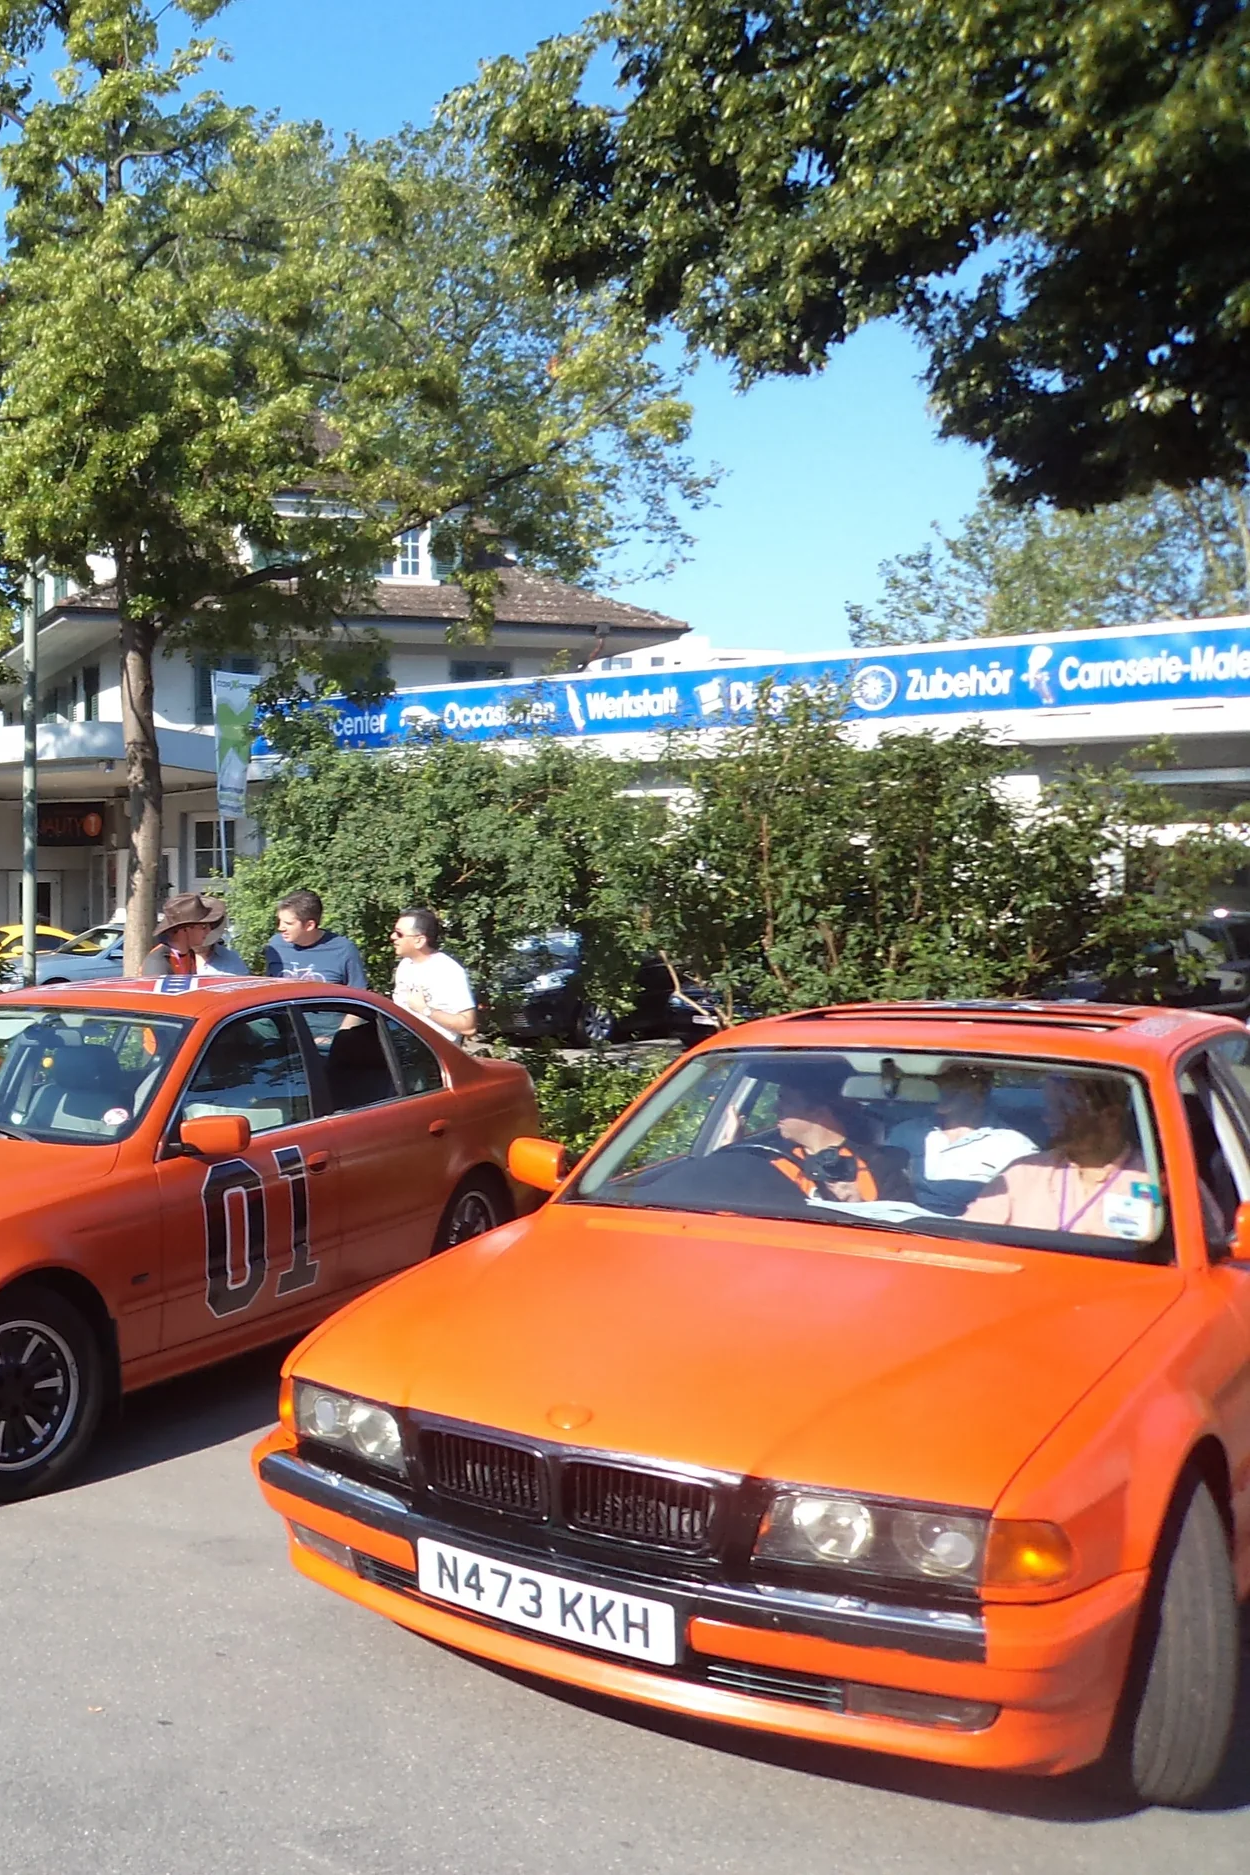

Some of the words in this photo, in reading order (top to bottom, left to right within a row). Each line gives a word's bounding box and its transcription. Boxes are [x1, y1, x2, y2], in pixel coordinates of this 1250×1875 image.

[586, 686, 679, 720] Werkstatt
[906, 661, 1014, 701] Zubehör
[201, 1145, 320, 1318] 01
[437, 1551, 542, 1619] N473
[558, 1586, 650, 1648] KKH
